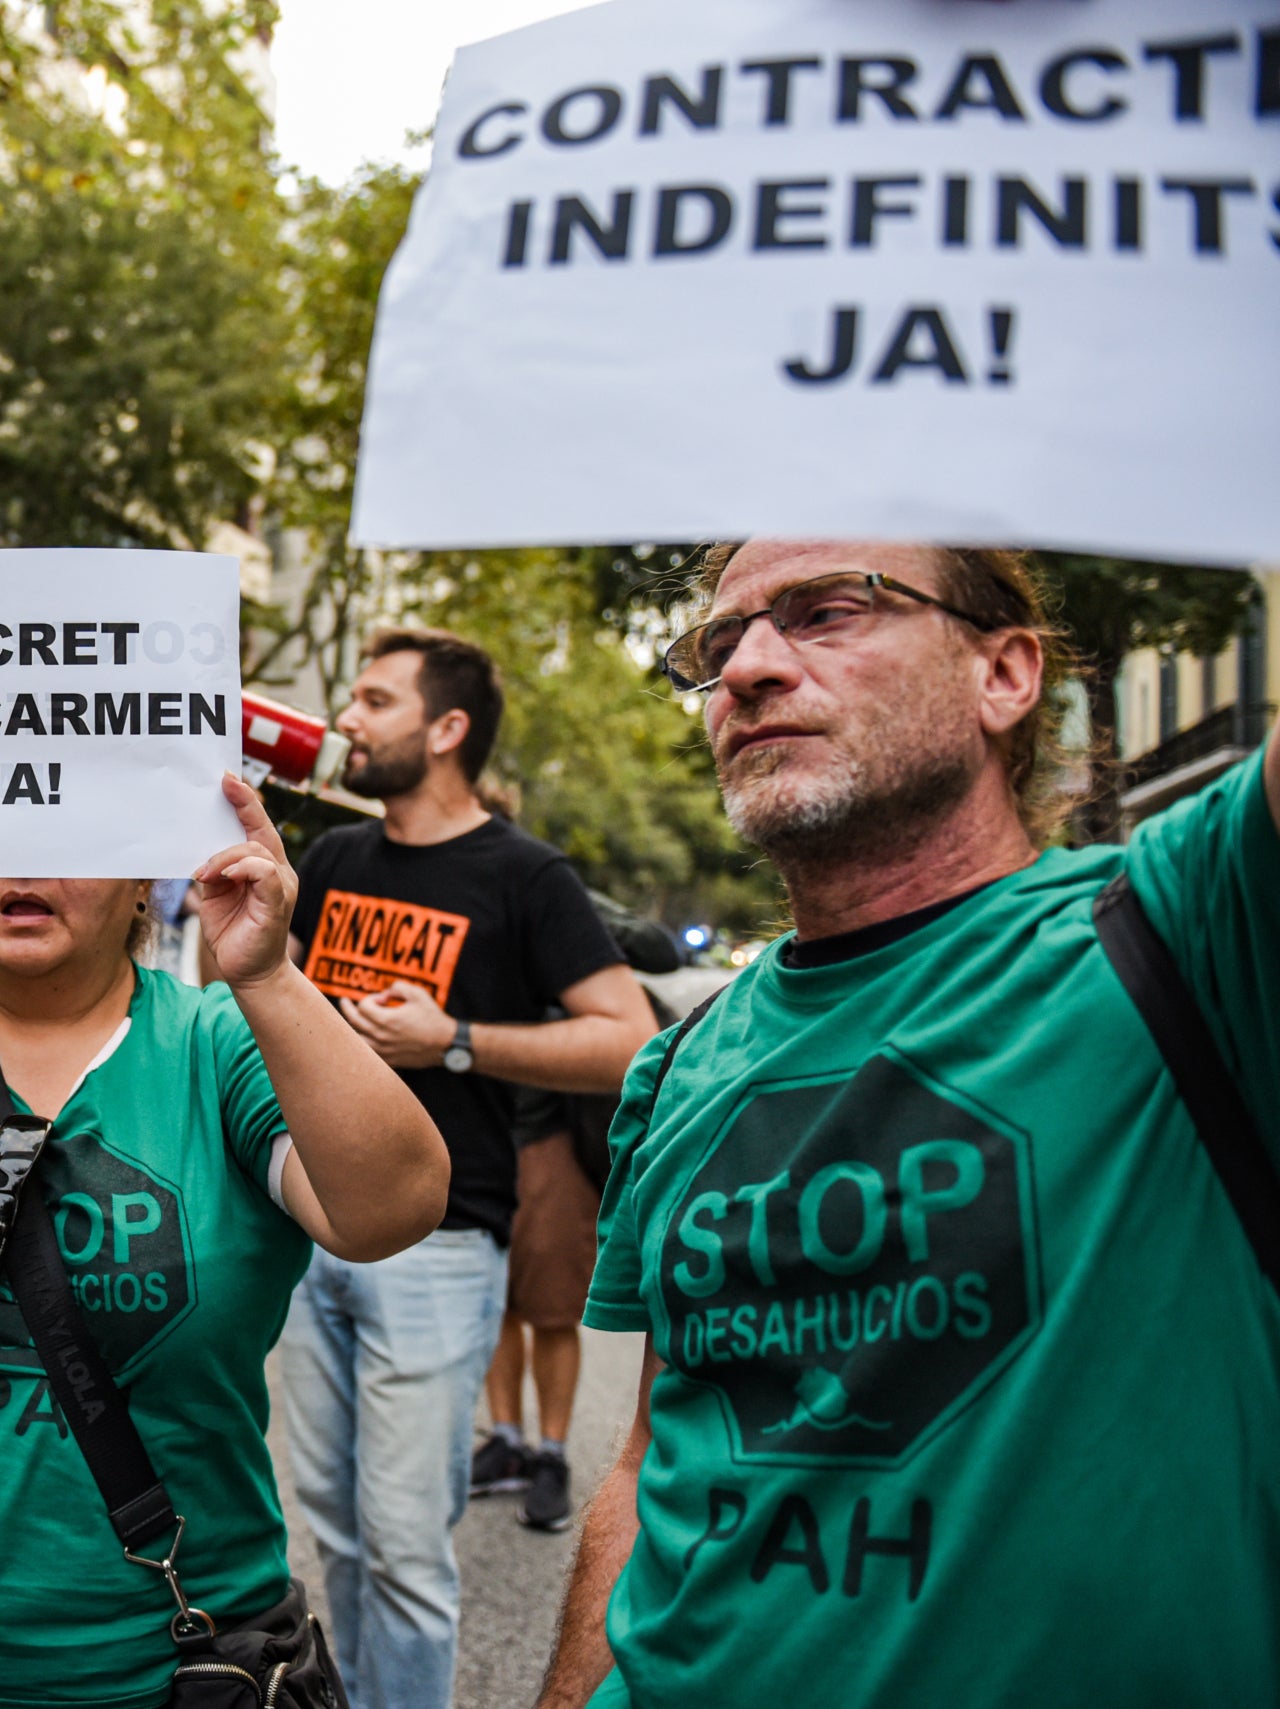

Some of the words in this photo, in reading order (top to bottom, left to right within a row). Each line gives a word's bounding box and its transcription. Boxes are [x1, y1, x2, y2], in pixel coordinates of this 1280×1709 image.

[457, 26, 1280, 160] CONTRACT
[500, 172, 1280, 270] INDEFINIT
[780, 304, 1018, 388] JA!
[323, 902, 456, 973] SINDICAT
[673, 1140, 985, 1298] STOP
[682, 1272, 992, 1367] DESAHUCIOS
[58, 1347, 108, 1425] LOLA
[683, 1487, 933, 1603] PAH
